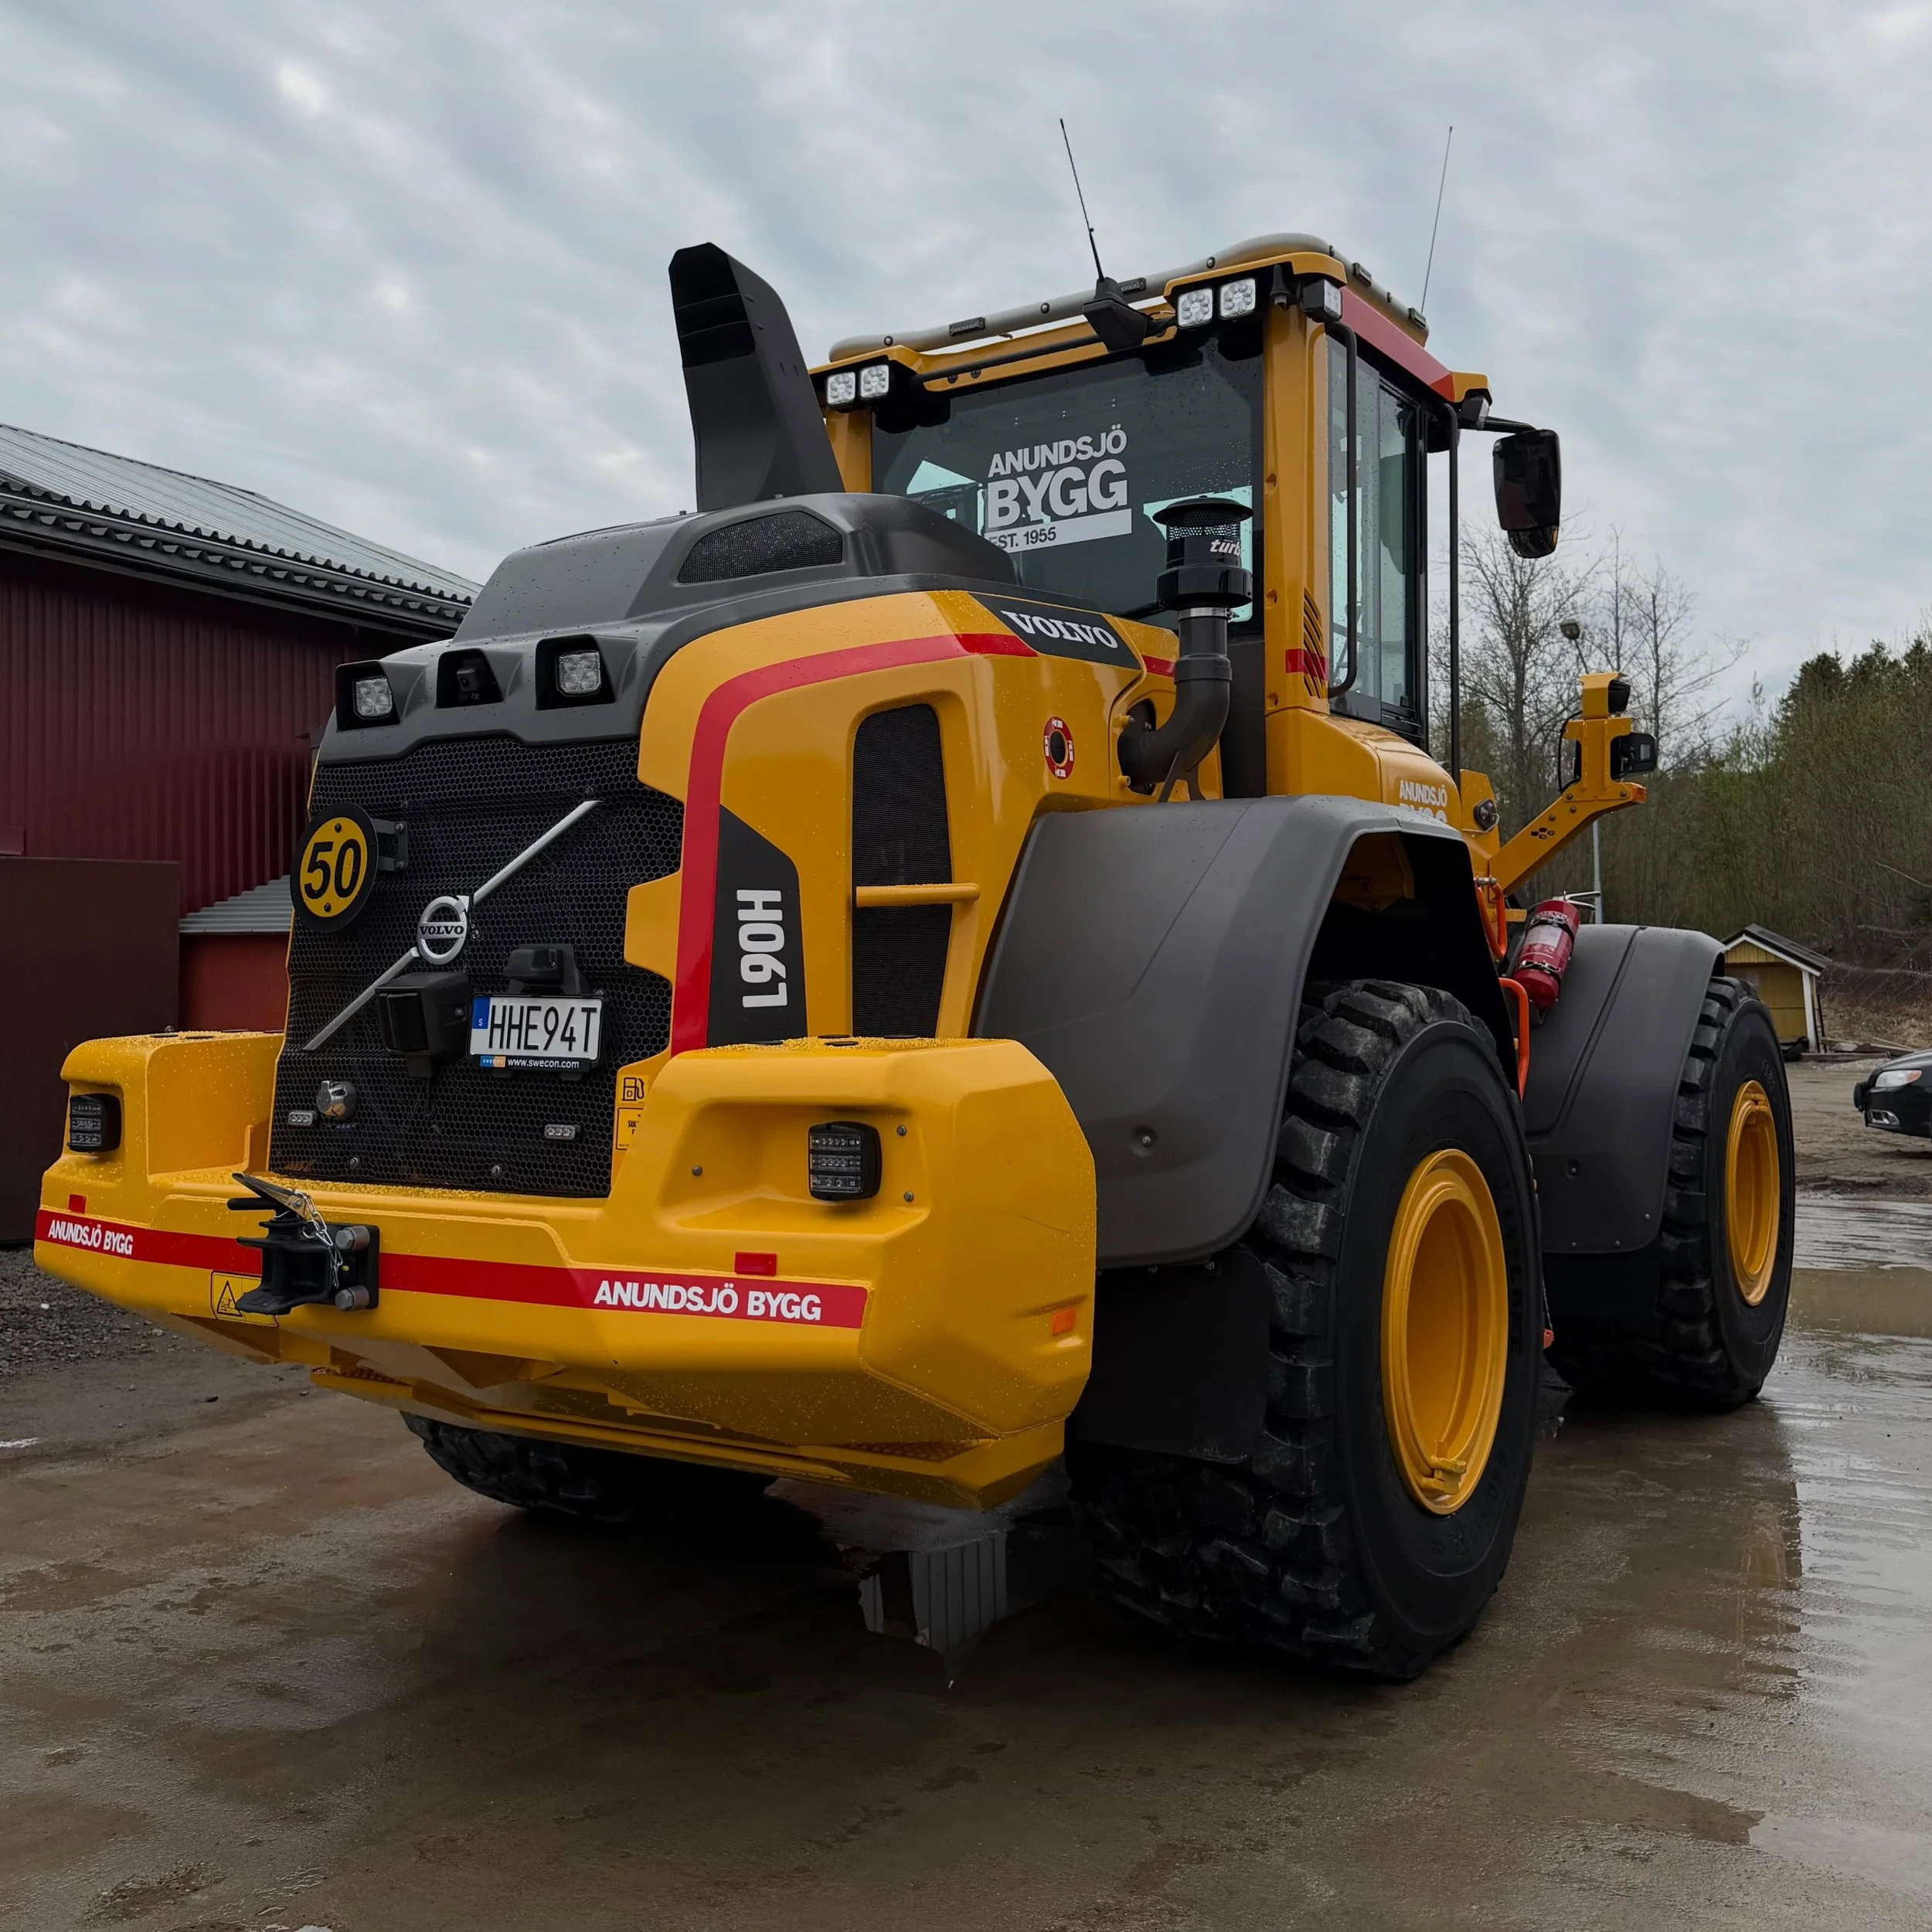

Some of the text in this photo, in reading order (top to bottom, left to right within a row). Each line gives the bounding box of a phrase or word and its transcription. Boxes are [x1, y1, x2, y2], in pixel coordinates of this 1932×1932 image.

[988, 423, 1128, 478] ANUNDSJÖ
[988, 459, 1128, 529] BYGG
[1023, 527, 1056, 546] 1955
[1000, 611, 1118, 648] VOLVO
[1400, 779, 1447, 808] ANUNDSJÖ
[304, 838, 361, 899] 50
[420, 925, 464, 934] VOLVO
[736, 889, 787, 1008] L90H
[478, 1005, 597, 1052] S HHE94T
[507, 1059, 580, 1069] www.swecon.com
[48, 1219, 134, 1255] ANUNDSJÖ BYGG
[594, 1280, 821, 1321] ANUNDSJÖ BYGG
